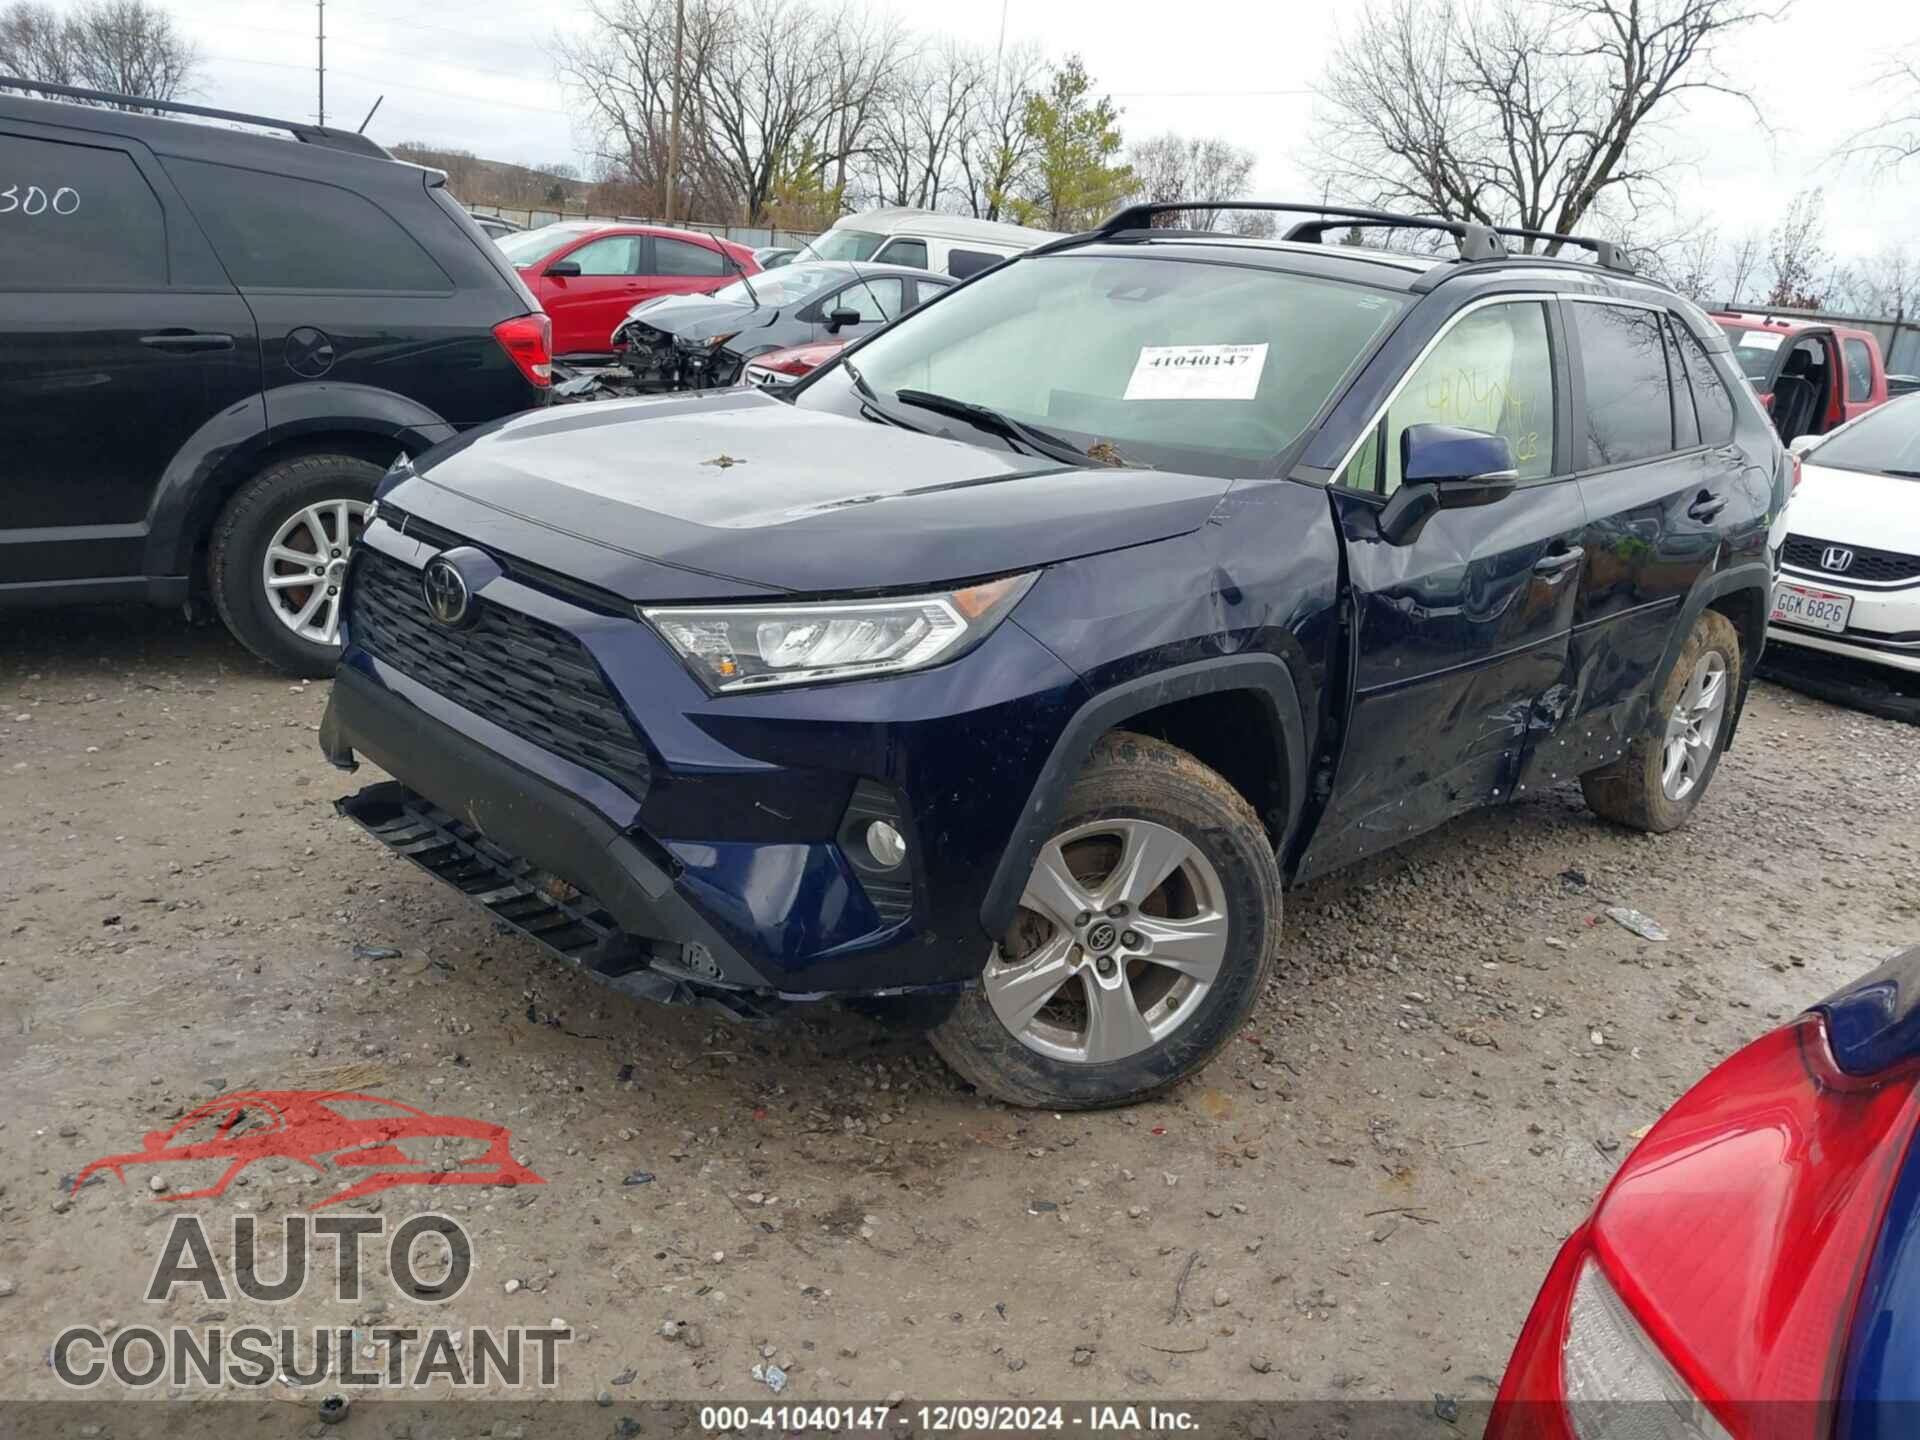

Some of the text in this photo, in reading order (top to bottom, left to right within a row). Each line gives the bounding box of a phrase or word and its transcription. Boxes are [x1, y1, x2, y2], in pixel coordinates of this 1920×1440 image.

[1149, 354, 1250, 367] 41040147
[1778, 593, 1803, 614] GGK
[1807, 599, 1842, 622] 6826
